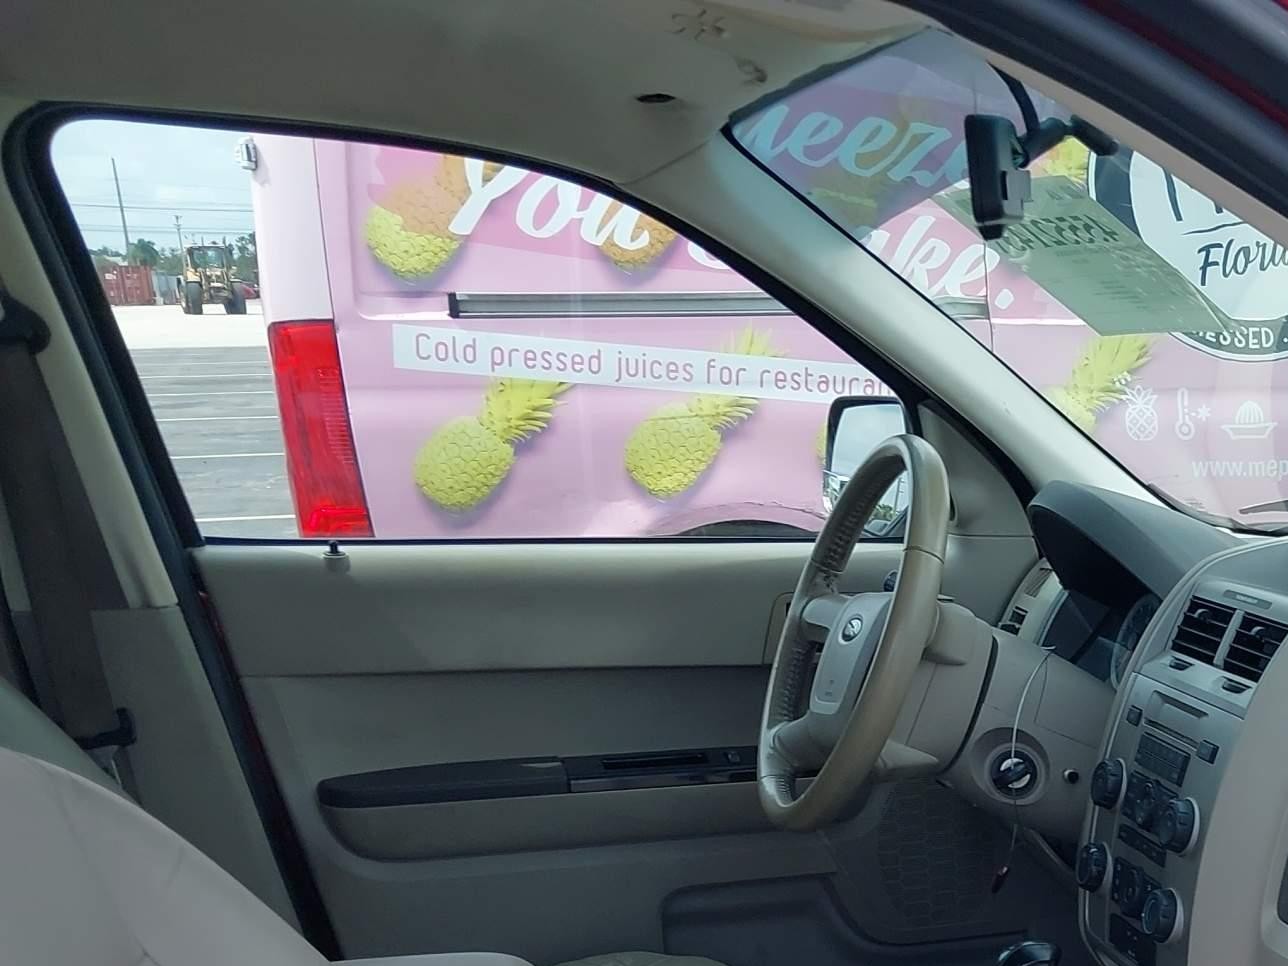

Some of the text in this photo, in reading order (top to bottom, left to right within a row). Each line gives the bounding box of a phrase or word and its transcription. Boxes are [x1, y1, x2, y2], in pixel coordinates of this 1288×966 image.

[448, 156, 650, 251] You
[414, 332, 478, 364] Cold
[490, 343, 602, 374] pressed
[614, 350, 694, 383] juices
[706, 358, 747, 387] for
